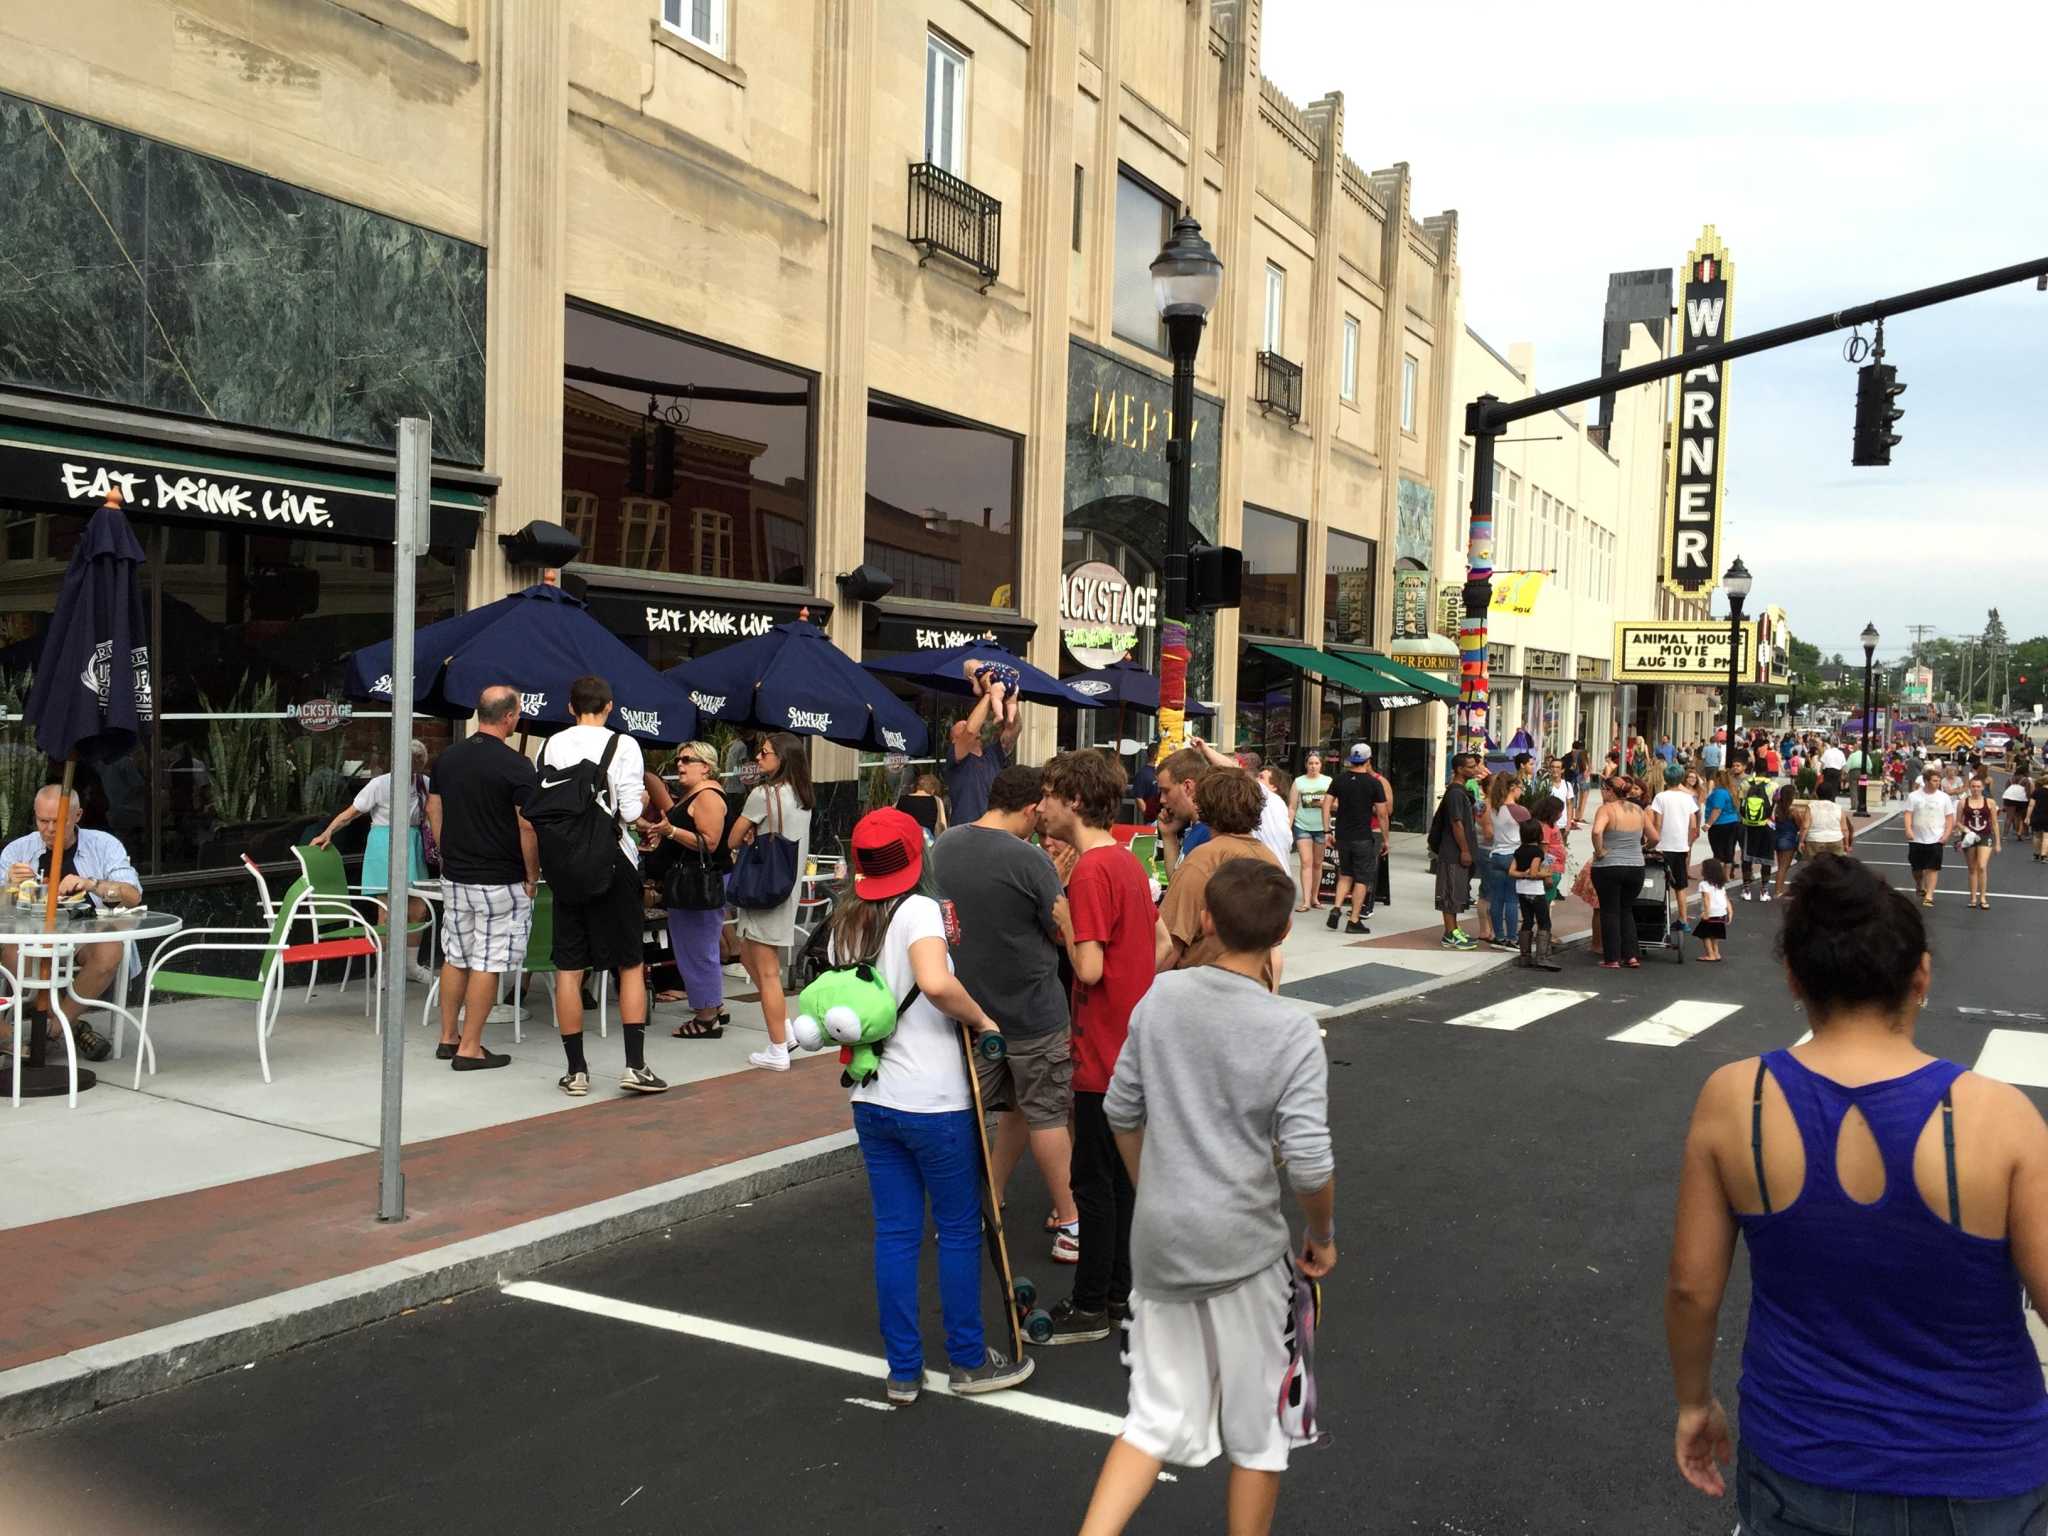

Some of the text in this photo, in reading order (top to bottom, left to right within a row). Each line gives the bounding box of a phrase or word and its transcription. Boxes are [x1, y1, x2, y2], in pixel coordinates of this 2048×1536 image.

[1677, 298, 1724, 569] WARNER
[61, 463, 150, 507] EAT.
[1060, 574, 1158, 627] ACKSTAGE
[646, 607, 686, 632] EAT.
[1405, 591, 1417, 634] ARTS
[1447, 598, 1458, 639] STUDIO
[916, 629, 944, 649] EAT.
[1633, 634, 1688, 644] ANIMAL
[1660, 645, 1709, 656] MOVIE
[1393, 655, 1457, 669] PERFORMIN
[1637, 656, 1731, 668] AUG 19 8 PM
[520, 693, 548, 706] UEL
[688, 690, 726, 707] SAMUEL
[287, 704, 353, 718] BACKSTAGE
[620, 706, 662, 725] SAMUEL
[788, 706, 833, 724] SAMUEL
[627, 719, 660, 736] ADAMS
[789, 718, 827, 733] ADAMS
